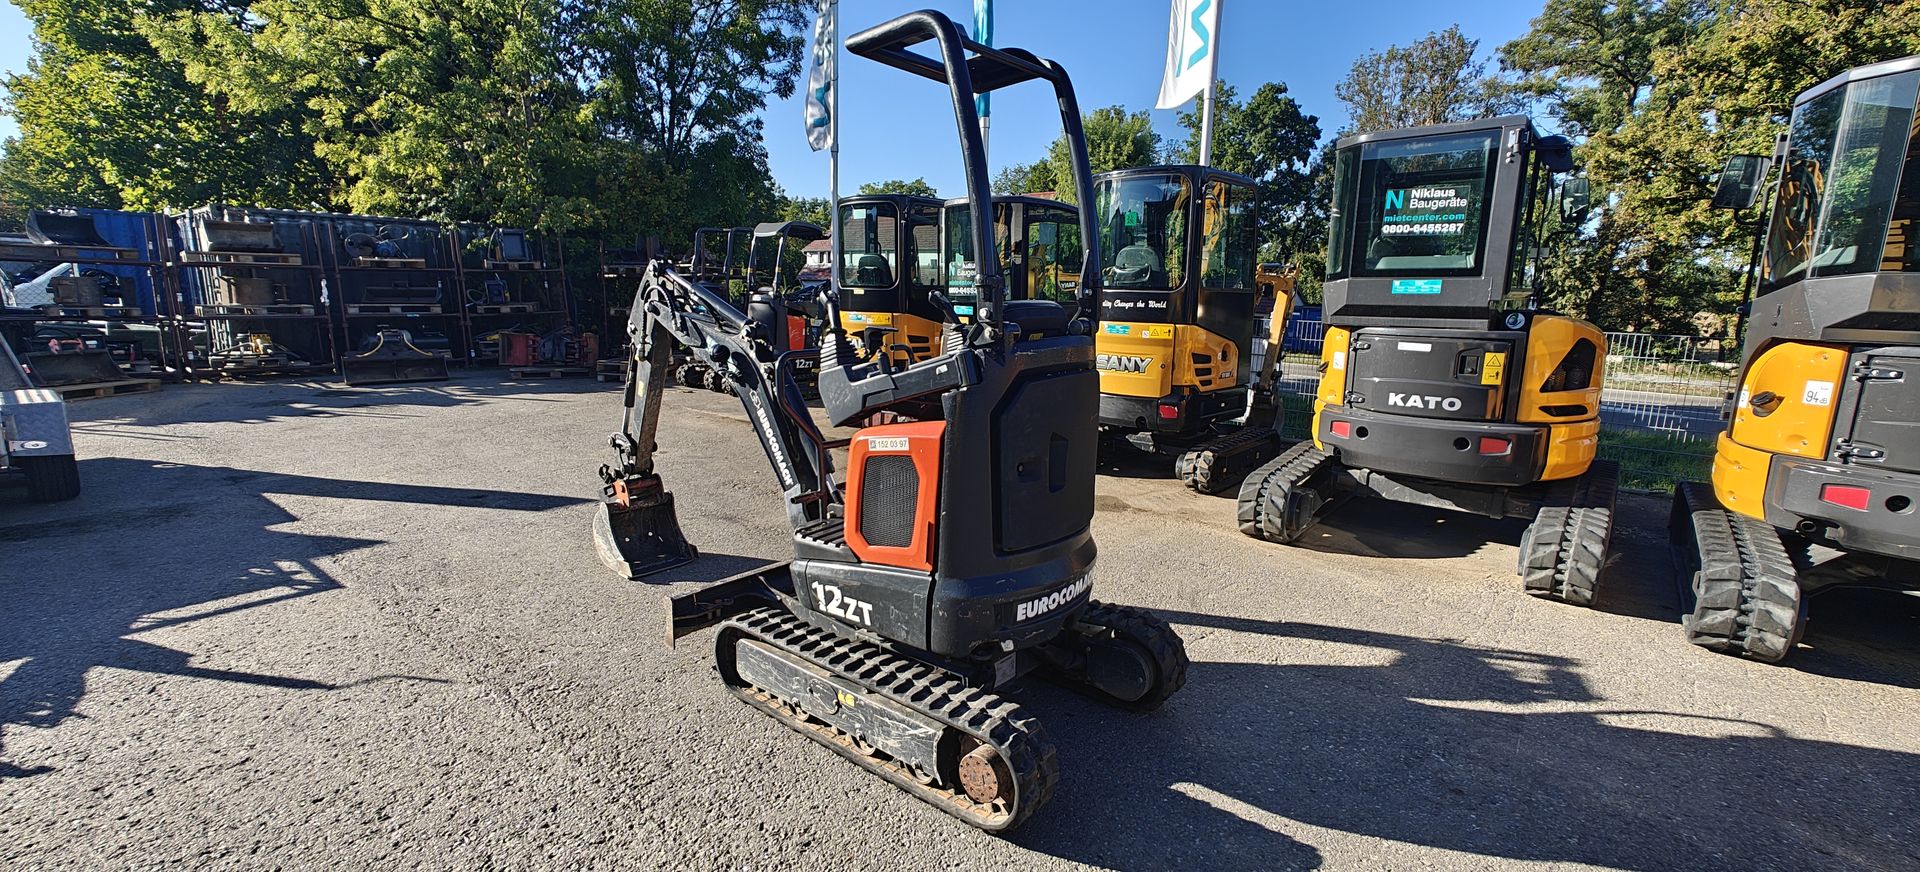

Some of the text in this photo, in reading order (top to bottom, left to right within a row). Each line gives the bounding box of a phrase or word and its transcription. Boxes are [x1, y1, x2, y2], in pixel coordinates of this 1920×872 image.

[1411, 188, 1455, 199] Niklaus
[1409, 197, 1467, 210] Baugeräte
[1384, 213, 1465, 222] mietcenter.com
[1382, 223, 1464, 234] 0800-6455287
[1114, 299, 1134, 310] Changes
[1136, 300, 1145, 308] the
[1148, 300, 1167, 309] World
[1096, 354, 1153, 373] SANY
[1388, 392, 1462, 412] KATO
[1806, 390, 1819, 403] 94
[756, 406, 794, 487] EUROCOMACH
[877, 439, 907, 448] 152 03 97
[811, 580, 873, 626] 12ZT
